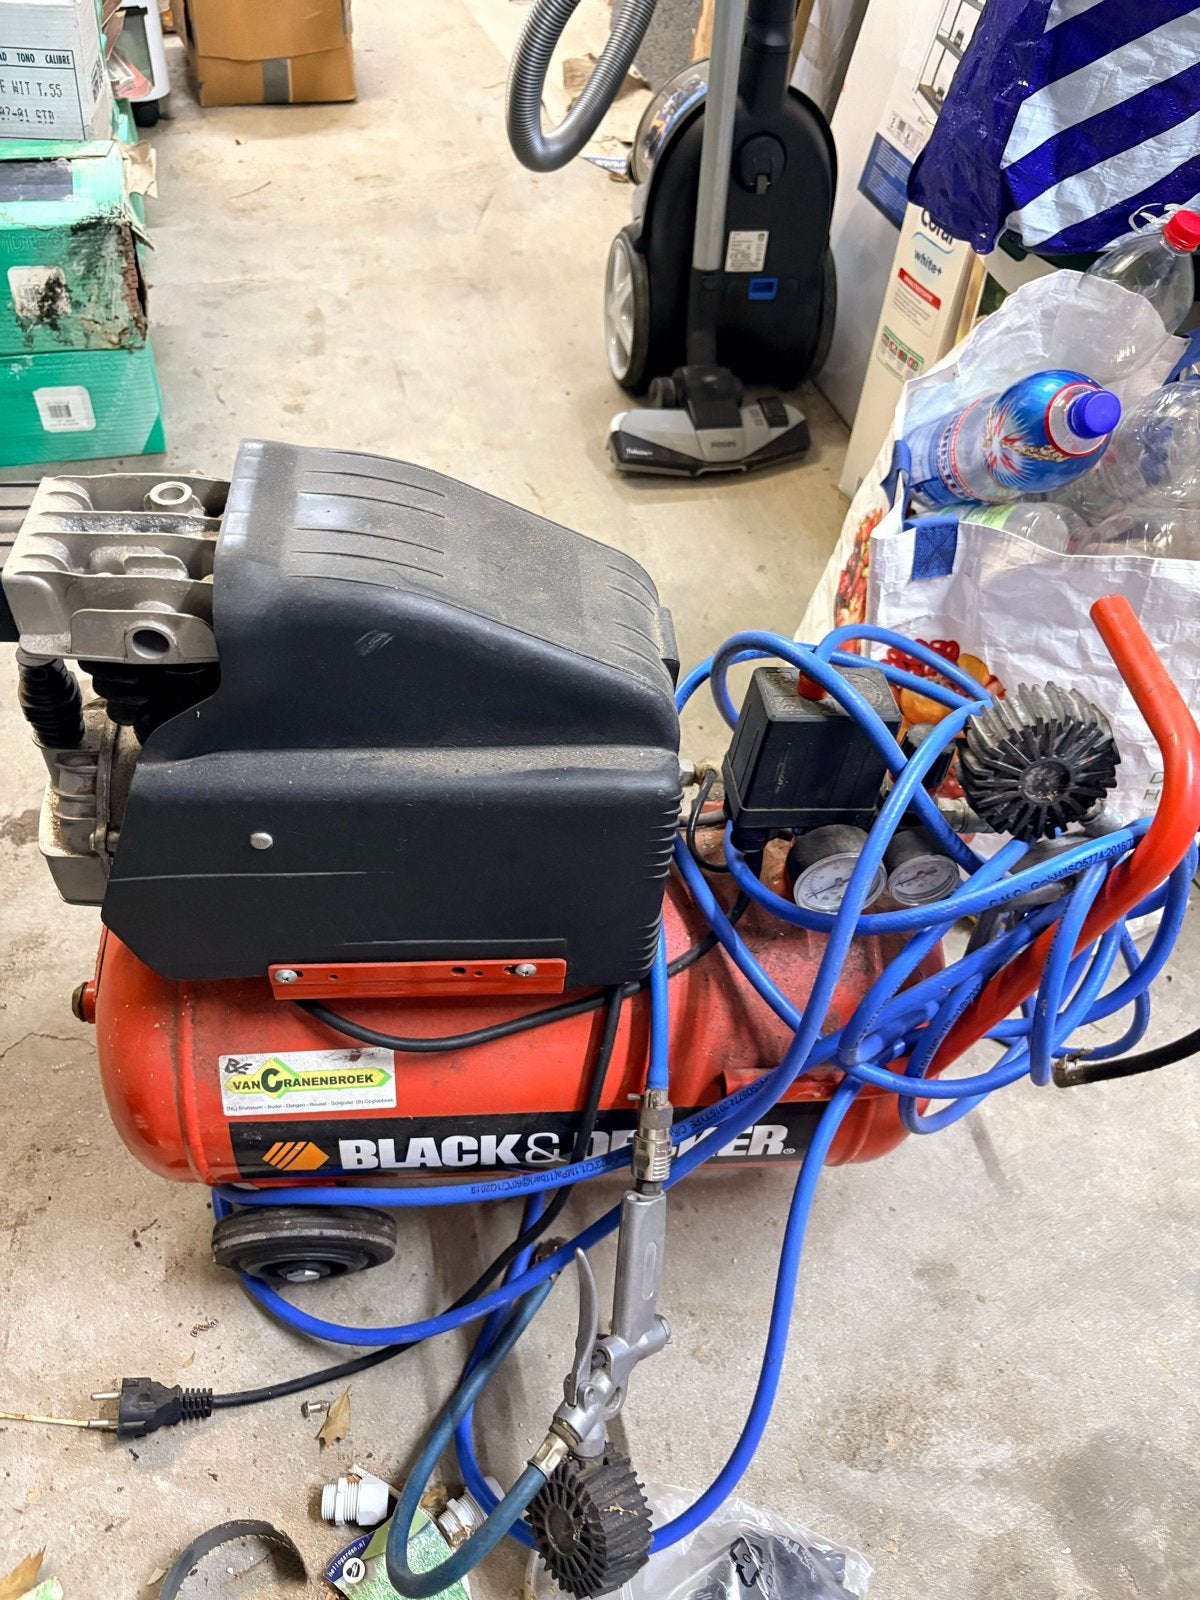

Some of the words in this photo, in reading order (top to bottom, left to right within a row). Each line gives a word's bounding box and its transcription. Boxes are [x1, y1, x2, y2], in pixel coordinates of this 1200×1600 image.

[17, 52, 35, 63] TONO
[45, 54, 70, 65] CALIBRE
[11, 80, 30, 95] WIT
[36, 82, 63, 98] T.55
[232, 1080, 262, 1091] VAN
[260, 1068, 375, 1093] CRANENBROEK
